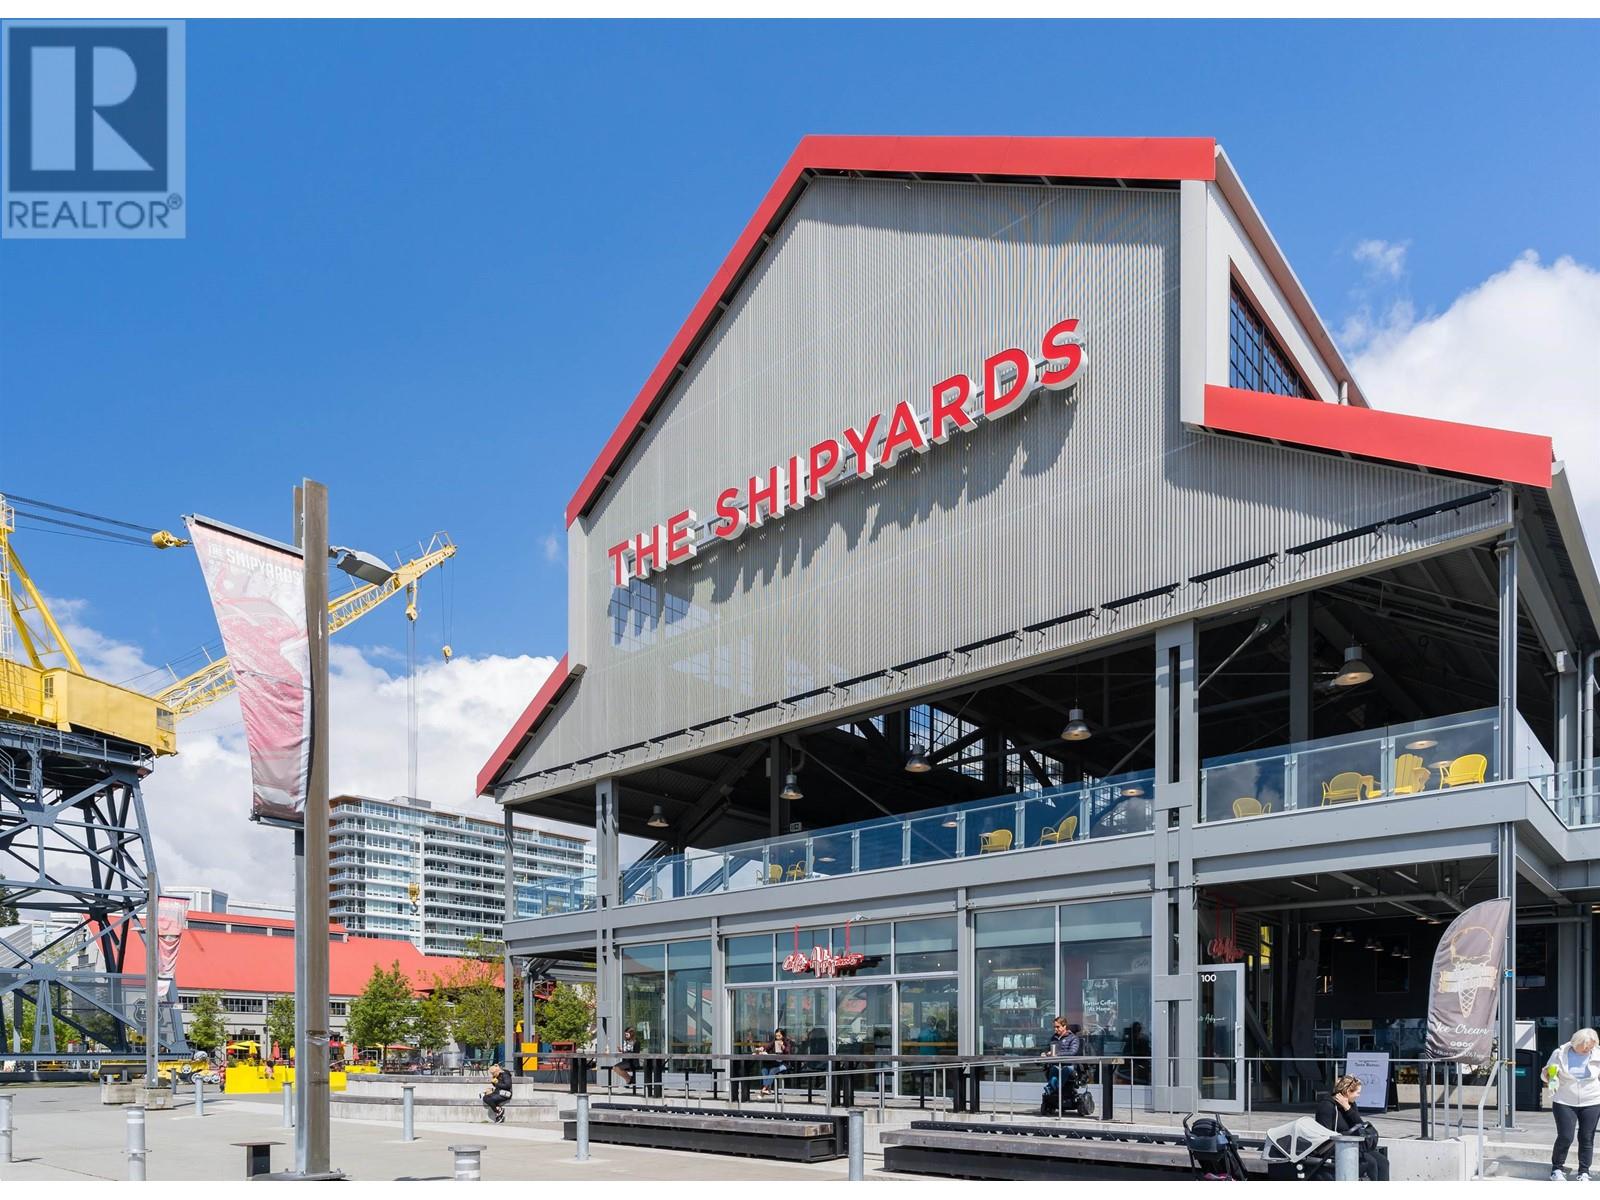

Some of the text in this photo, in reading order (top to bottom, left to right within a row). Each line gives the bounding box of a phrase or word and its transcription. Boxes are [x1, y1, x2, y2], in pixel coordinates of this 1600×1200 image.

[608, 318, 1088, 588] THE SHIPYARDS
[226, 549, 302, 584] SHIPYARDS
[1201, 974, 1217, 982] 100
[1434, 1022, 1489, 1035] Ice Cream
